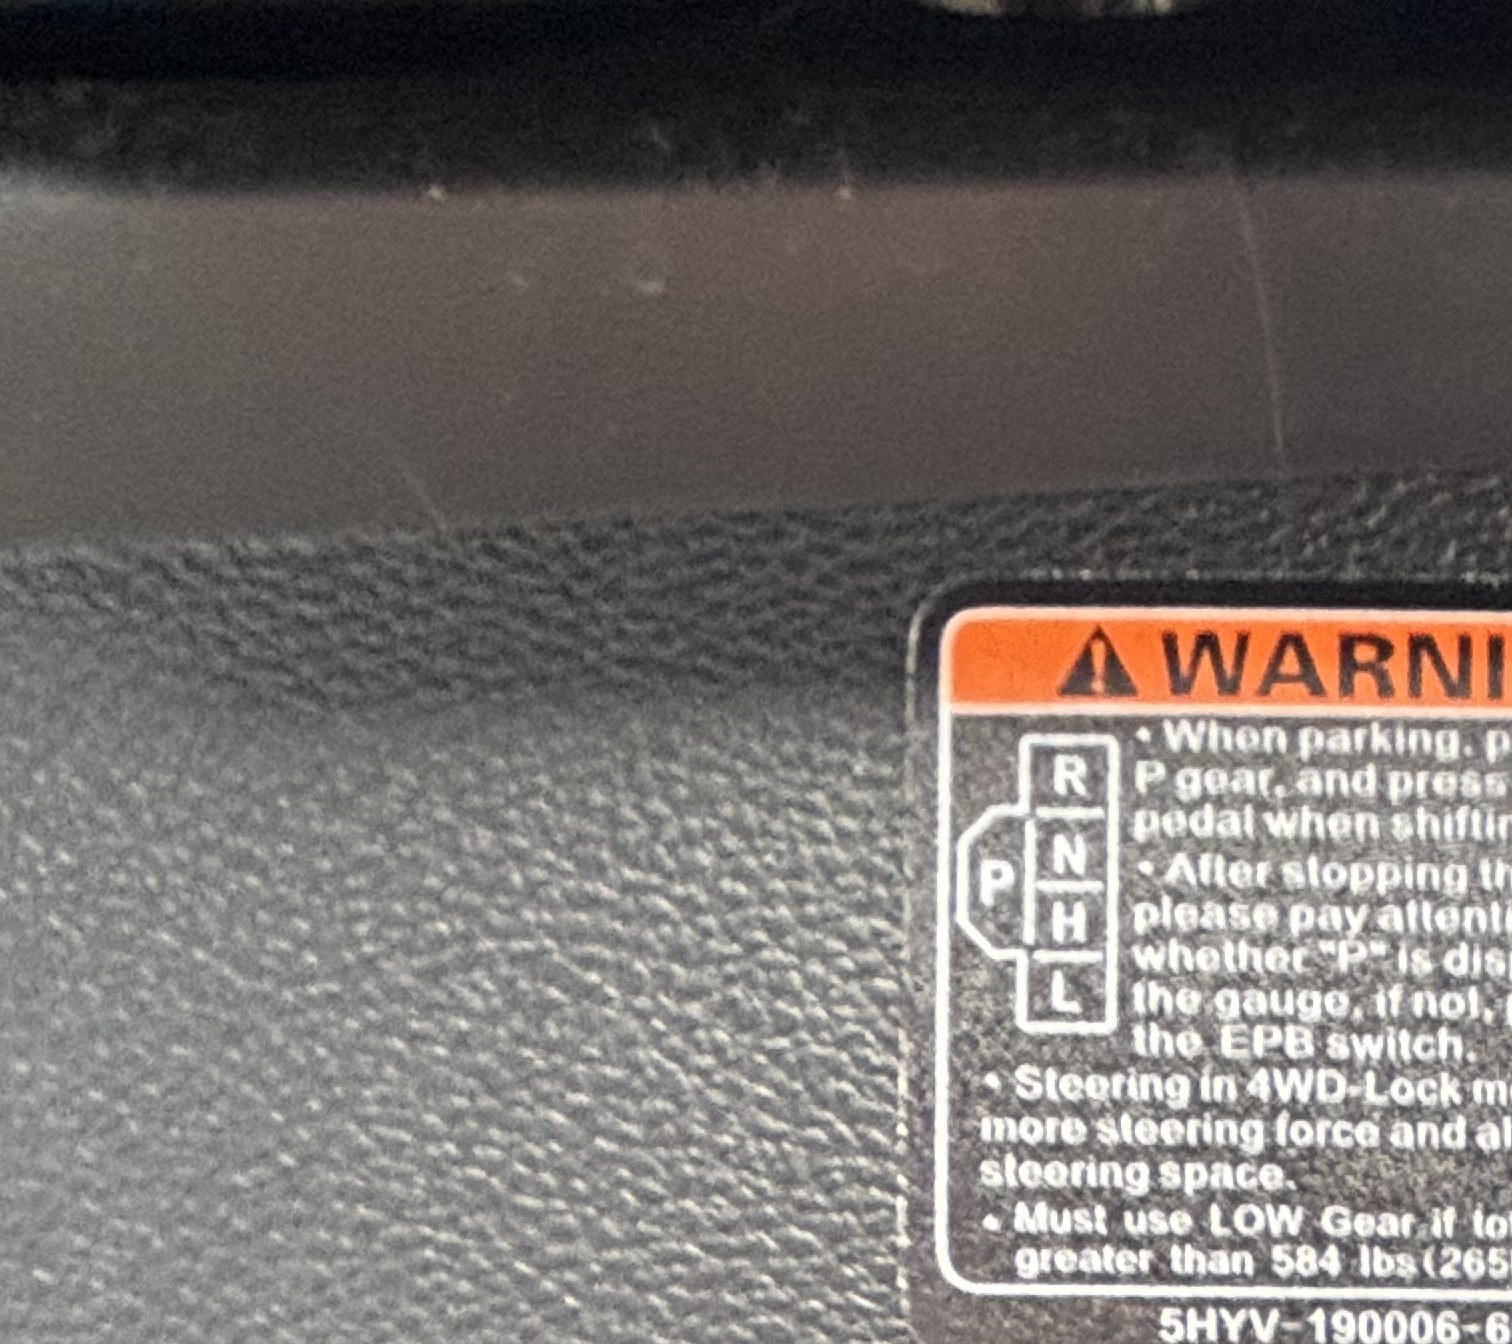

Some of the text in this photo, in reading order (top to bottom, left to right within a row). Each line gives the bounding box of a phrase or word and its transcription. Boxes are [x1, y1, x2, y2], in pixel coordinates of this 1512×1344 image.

[1163, 718, 1287, 754] When
[1053, 754, 1088, 797] R
[1135, 759, 1166, 796] P
[1297, 762, 1377, 798] and
[1388, 769, 1507, 806] press
[1133, 803, 1254, 844] pedal
[1262, 805, 1380, 842] when
[1052, 834, 1087, 875] N
[1164, 852, 1271, 888] After
[1282, 853, 1468, 897] stopping
[979, 859, 1014, 906] P
[1052, 901, 1088, 943] H
[1132, 896, 1279, 935] please
[1289, 902, 1369, 936] pay
[1132, 936, 1308, 974] whether
[1399, 942, 1433, 977] is
[1051, 970, 1081, 1014] L
[1132, 980, 1202, 1015] the
[1374, 983, 1402, 1019] if
[1132, 1022, 1478, 1063] the EPB switch.
[1014, 1063, 1190, 1109] Steering
[1200, 1066, 1237, 1101] in
[1246, 1067, 1461, 1106] 4WD-Lock
[980, 1115, 1087, 1145] more
[1097, 1112, 1265, 1155] steering
[1276, 1110, 1379, 1148] force
[1390, 1116, 1466, 1150] and
[979, 1153, 1297, 1197] steering space.
[1013, 1201, 1107, 1235] Must
[1124, 1208, 1193, 1236] use
[1210, 1204, 1303, 1237] LOW
[1432, 1206, 1456, 1239] if
[1014, 1244, 1154, 1279] greater
[1170, 1244, 1254, 1277] than
[1270, 1245, 1341, 1278] 584
